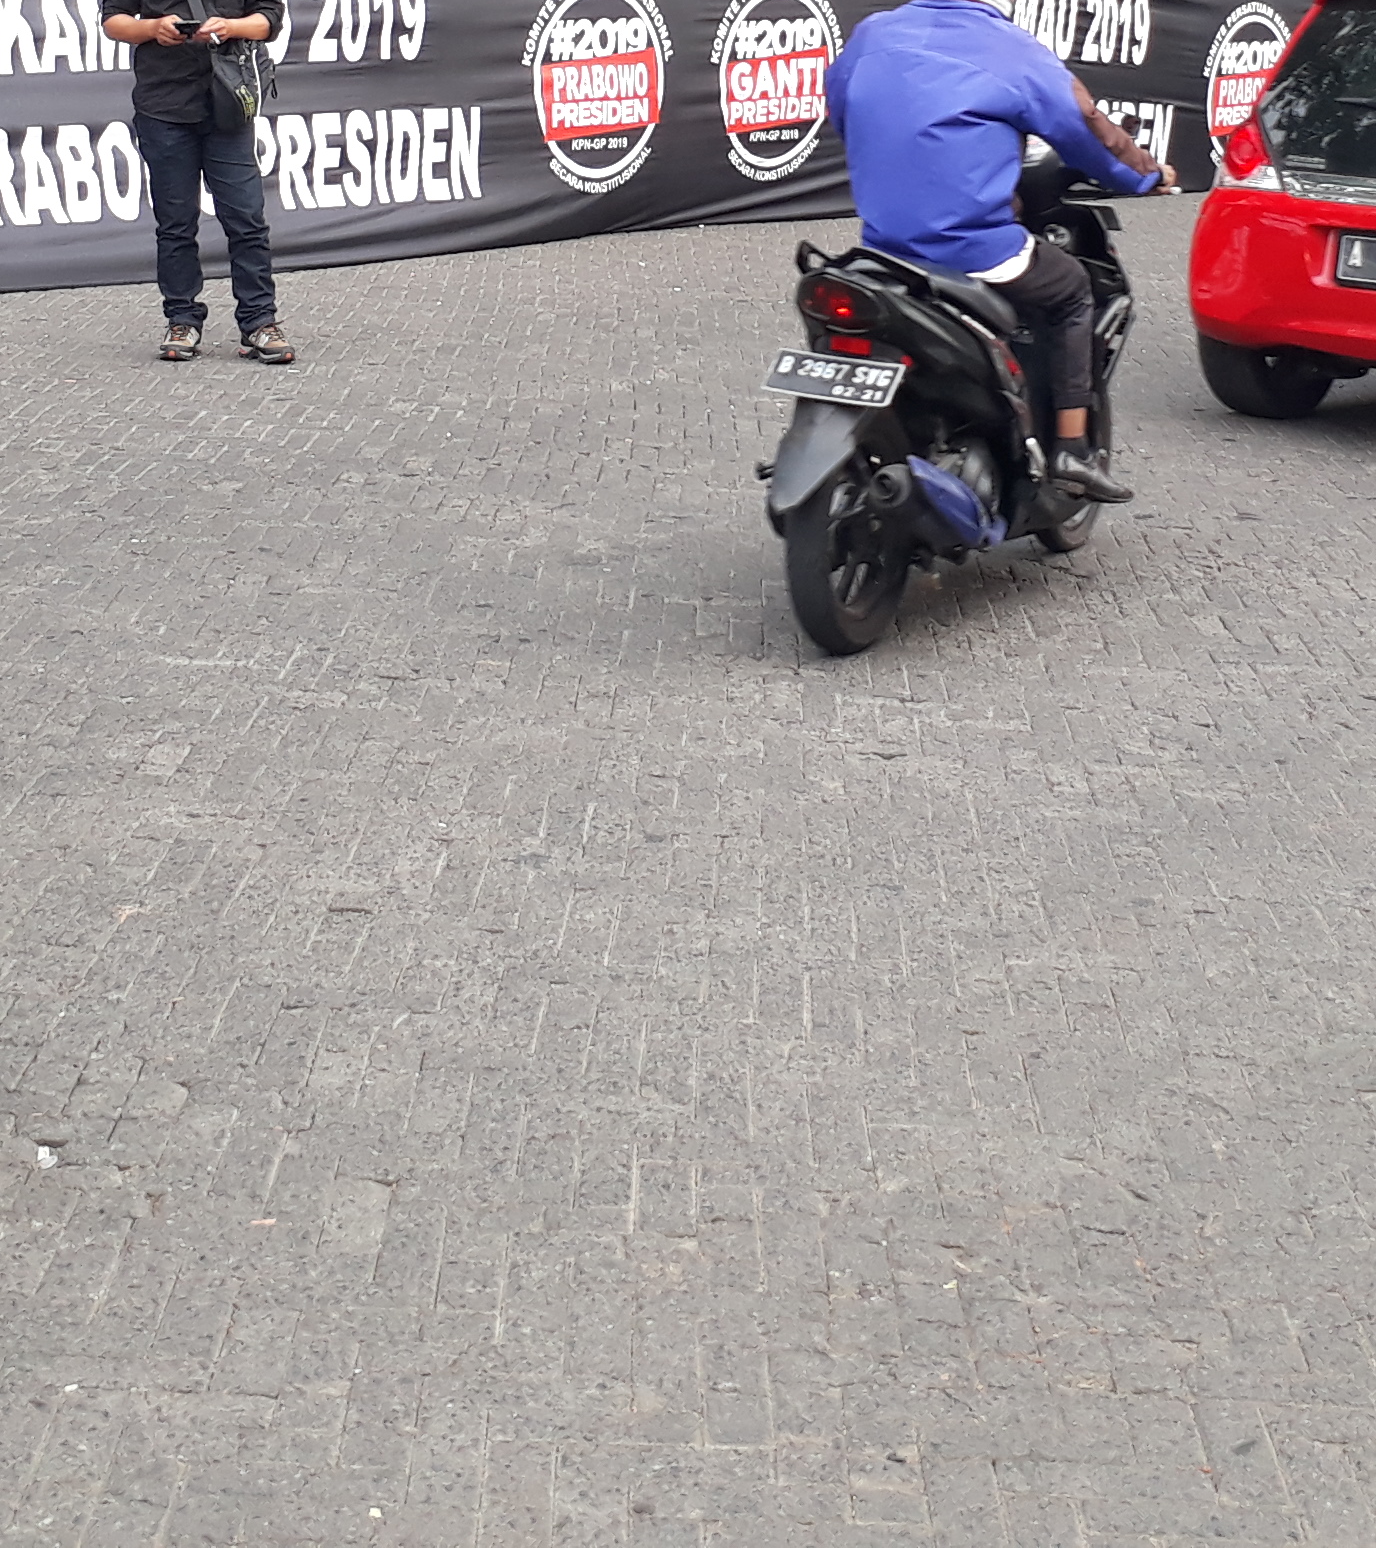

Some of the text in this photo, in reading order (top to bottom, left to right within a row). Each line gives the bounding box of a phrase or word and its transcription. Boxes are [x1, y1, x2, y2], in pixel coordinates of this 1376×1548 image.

[549, 16, 648, 62] #2019
[734, 17, 823, 60] #2019
[1202, 23, 1227, 78] KOMITE
[1225, 1, 1275, 28] PERSATUAN
[1221, 40, 1283, 75] #2019
[550, 62, 649, 102] PRABOWO
[730, 56, 825, 101] GANTI
[550, 97, 649, 129] PRESIDEN
[729, 95, 826, 125] PRESIDEN
[254, 106, 483, 210] PRESIDEN
[549, 145, 652, 194] SECARA KONSTITUSIONAL
[727, 137, 820, 182] SECARA KONSTITUSIONAL
[1347, 240, 1363, 267] A
[777, 355, 796, 373] B
